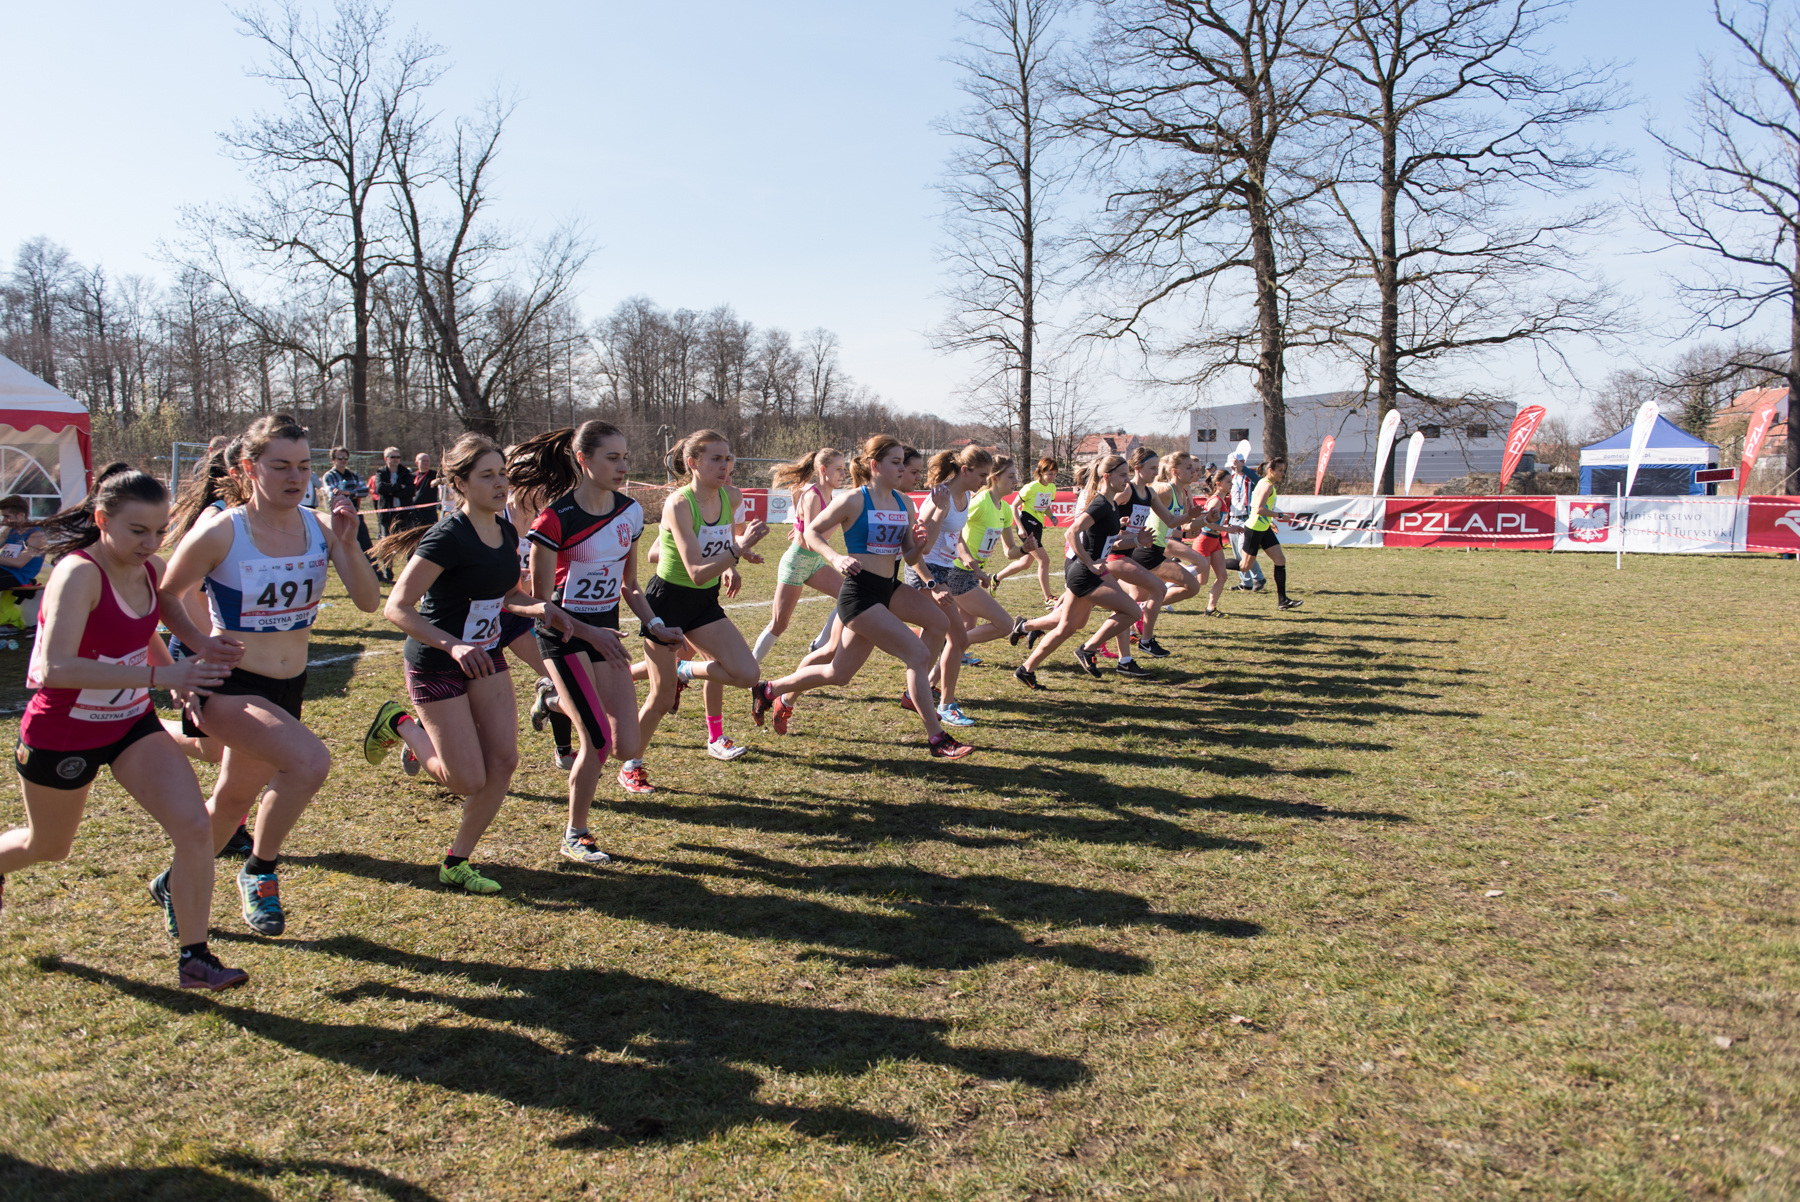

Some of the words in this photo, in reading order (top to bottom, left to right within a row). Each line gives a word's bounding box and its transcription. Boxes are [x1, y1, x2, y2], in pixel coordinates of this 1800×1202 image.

[1508, 410, 1542, 454] PZLA
[1745, 409, 1772, 457] PZLA
[1040, 499, 1049, 507] 34
[1051, 505, 1076, 514] RLE
[1400, 513, 1539, 533] PZLA.PL
[1619, 512, 1702, 521] Ministerstwo
[876, 524, 905, 543] 374
[1673, 526, 1733, 539] Turystyki
[702, 539, 730, 558] 529
[314, 559, 325, 567] LUG
[256, 578, 313, 608] 491
[574, 578, 617, 600] 252
[258, 616, 292, 626] OLSZYNA
[295, 612, 310, 621] 2019
[471, 617, 498, 640] 28
[126, 706, 140, 717] 2019
